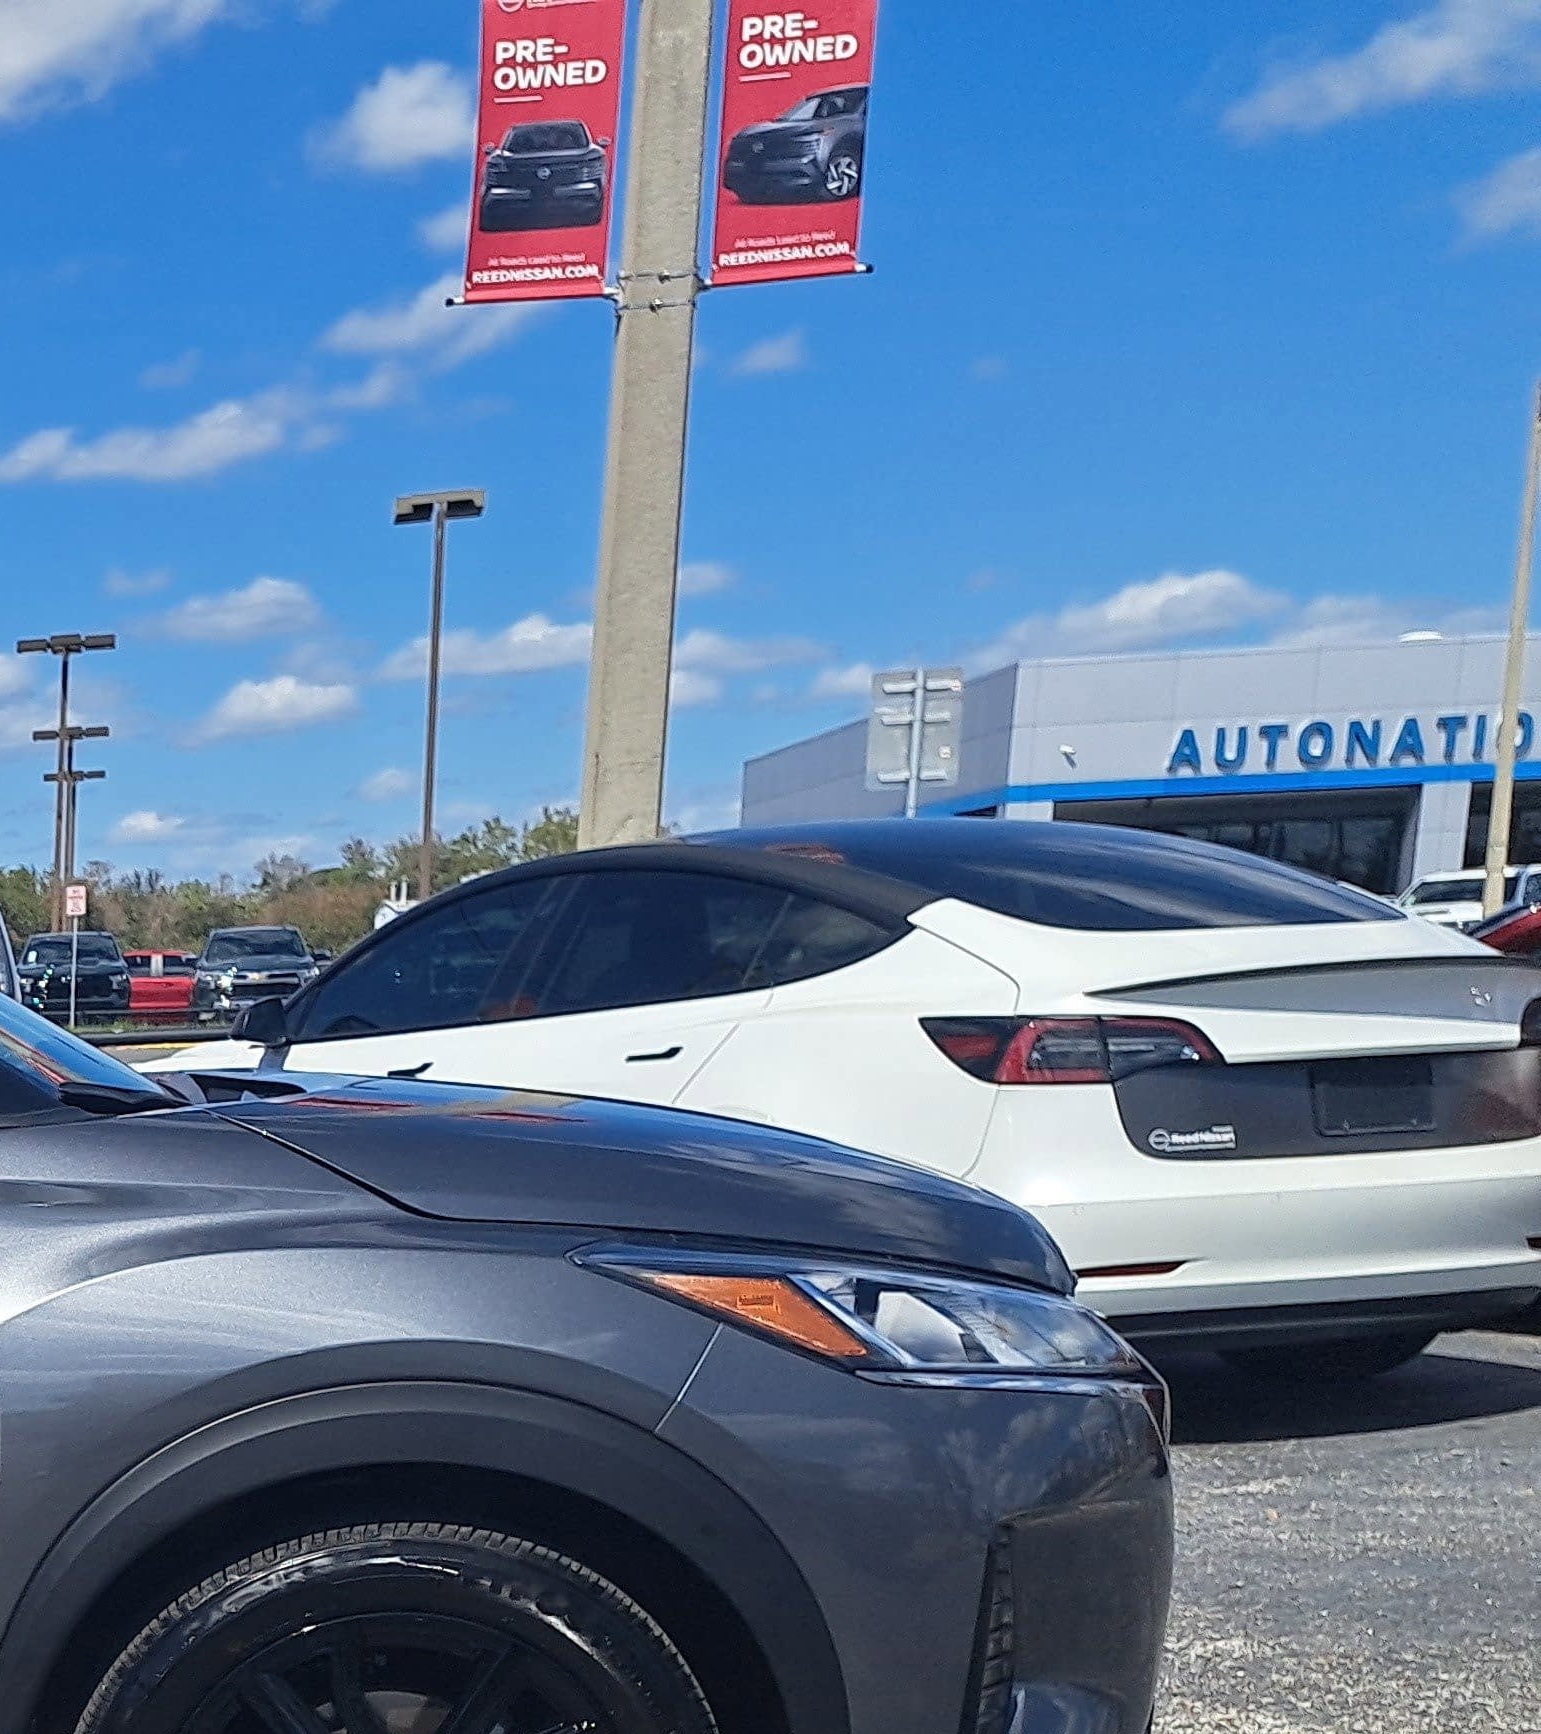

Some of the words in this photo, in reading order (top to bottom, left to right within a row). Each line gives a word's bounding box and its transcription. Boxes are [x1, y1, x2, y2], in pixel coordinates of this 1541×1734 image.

[742, 13, 819, 42] PRE-
[495, 38, 569, 65] PRE-
[739, 34, 858, 69] OWNED
[493, 59, 607, 91] OWNED
